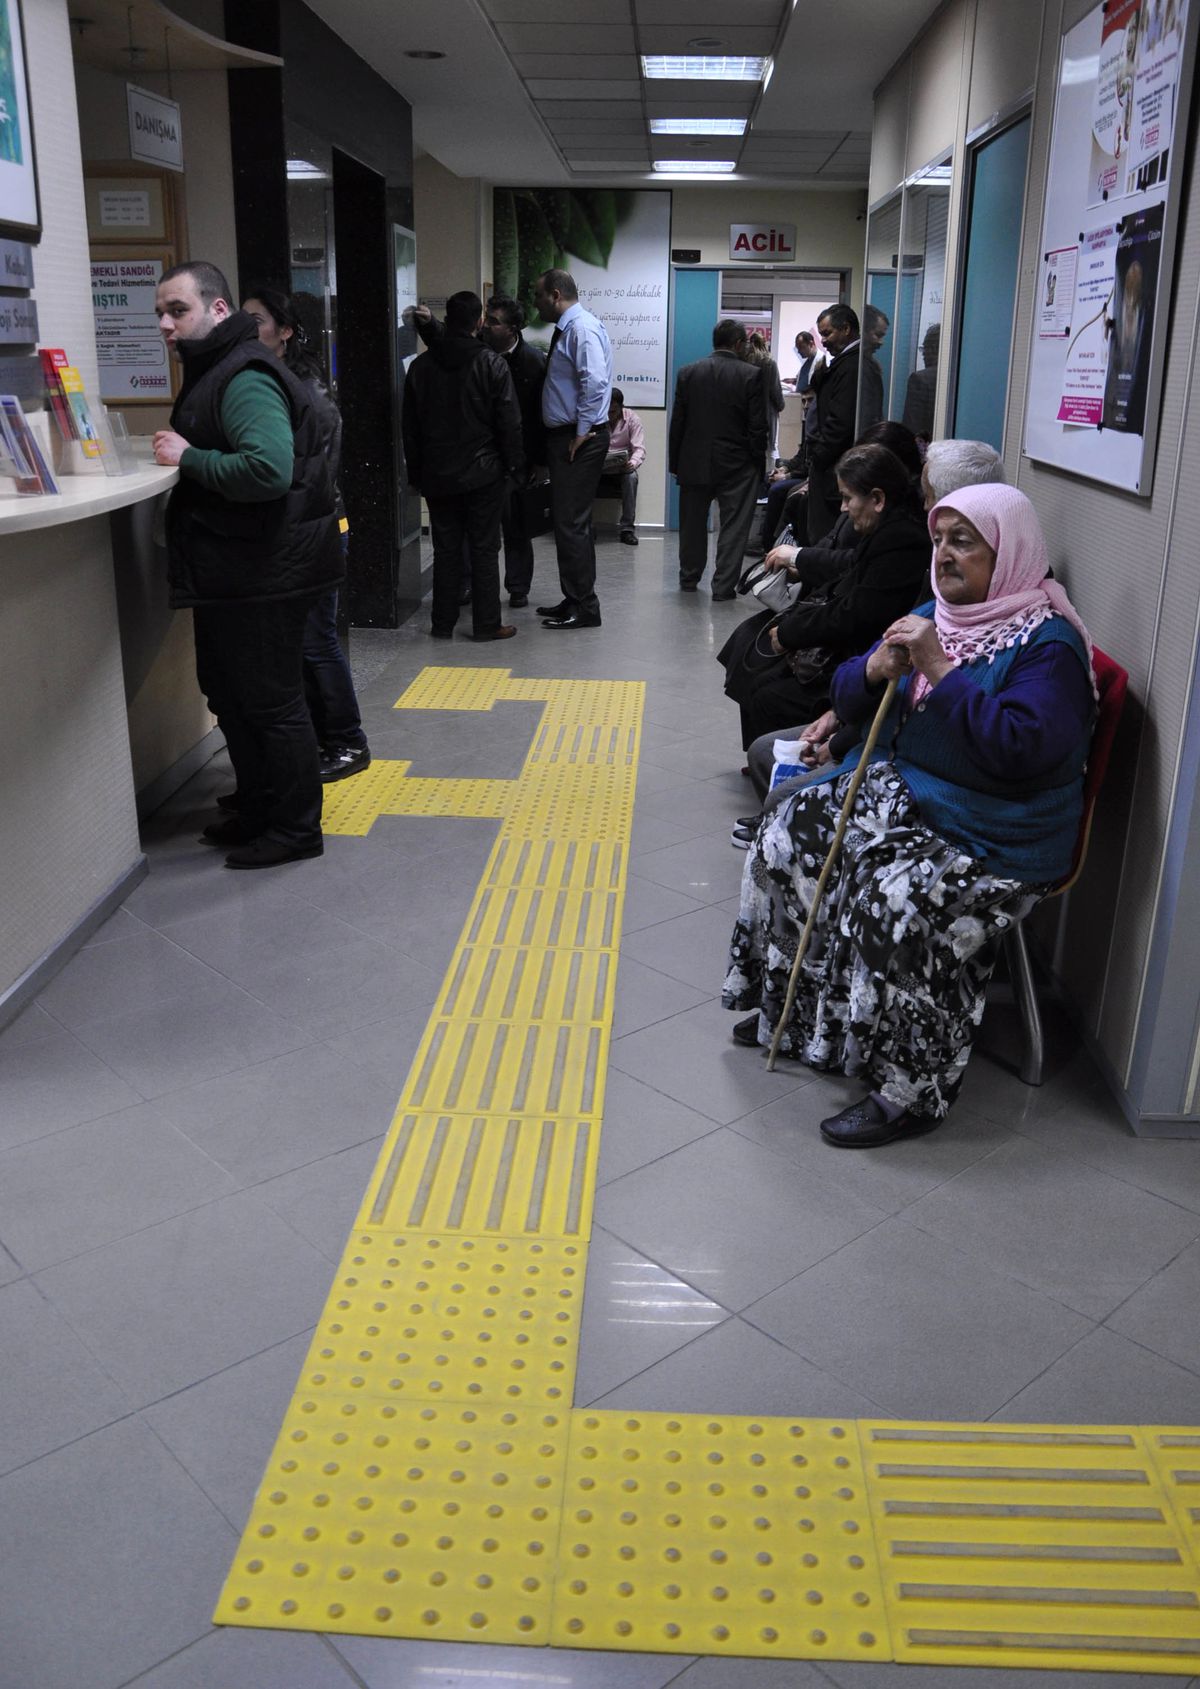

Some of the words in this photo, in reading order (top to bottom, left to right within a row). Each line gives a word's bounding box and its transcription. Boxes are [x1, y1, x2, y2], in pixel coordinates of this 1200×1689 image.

[134, 111, 177, 143] DANIŞMA
[733, 229, 792, 252] ACİL
[120, 263, 155, 276] SANDIĞI
[588, 287, 602, 301] gün
[604, 289, 625, 299] 10-30
[626, 284, 662, 298] dakikalık
[599, 312, 628, 326] yürüyüş
[629, 312, 651, 326] yapın
[616, 374, 660, 383] Olmaktır.
